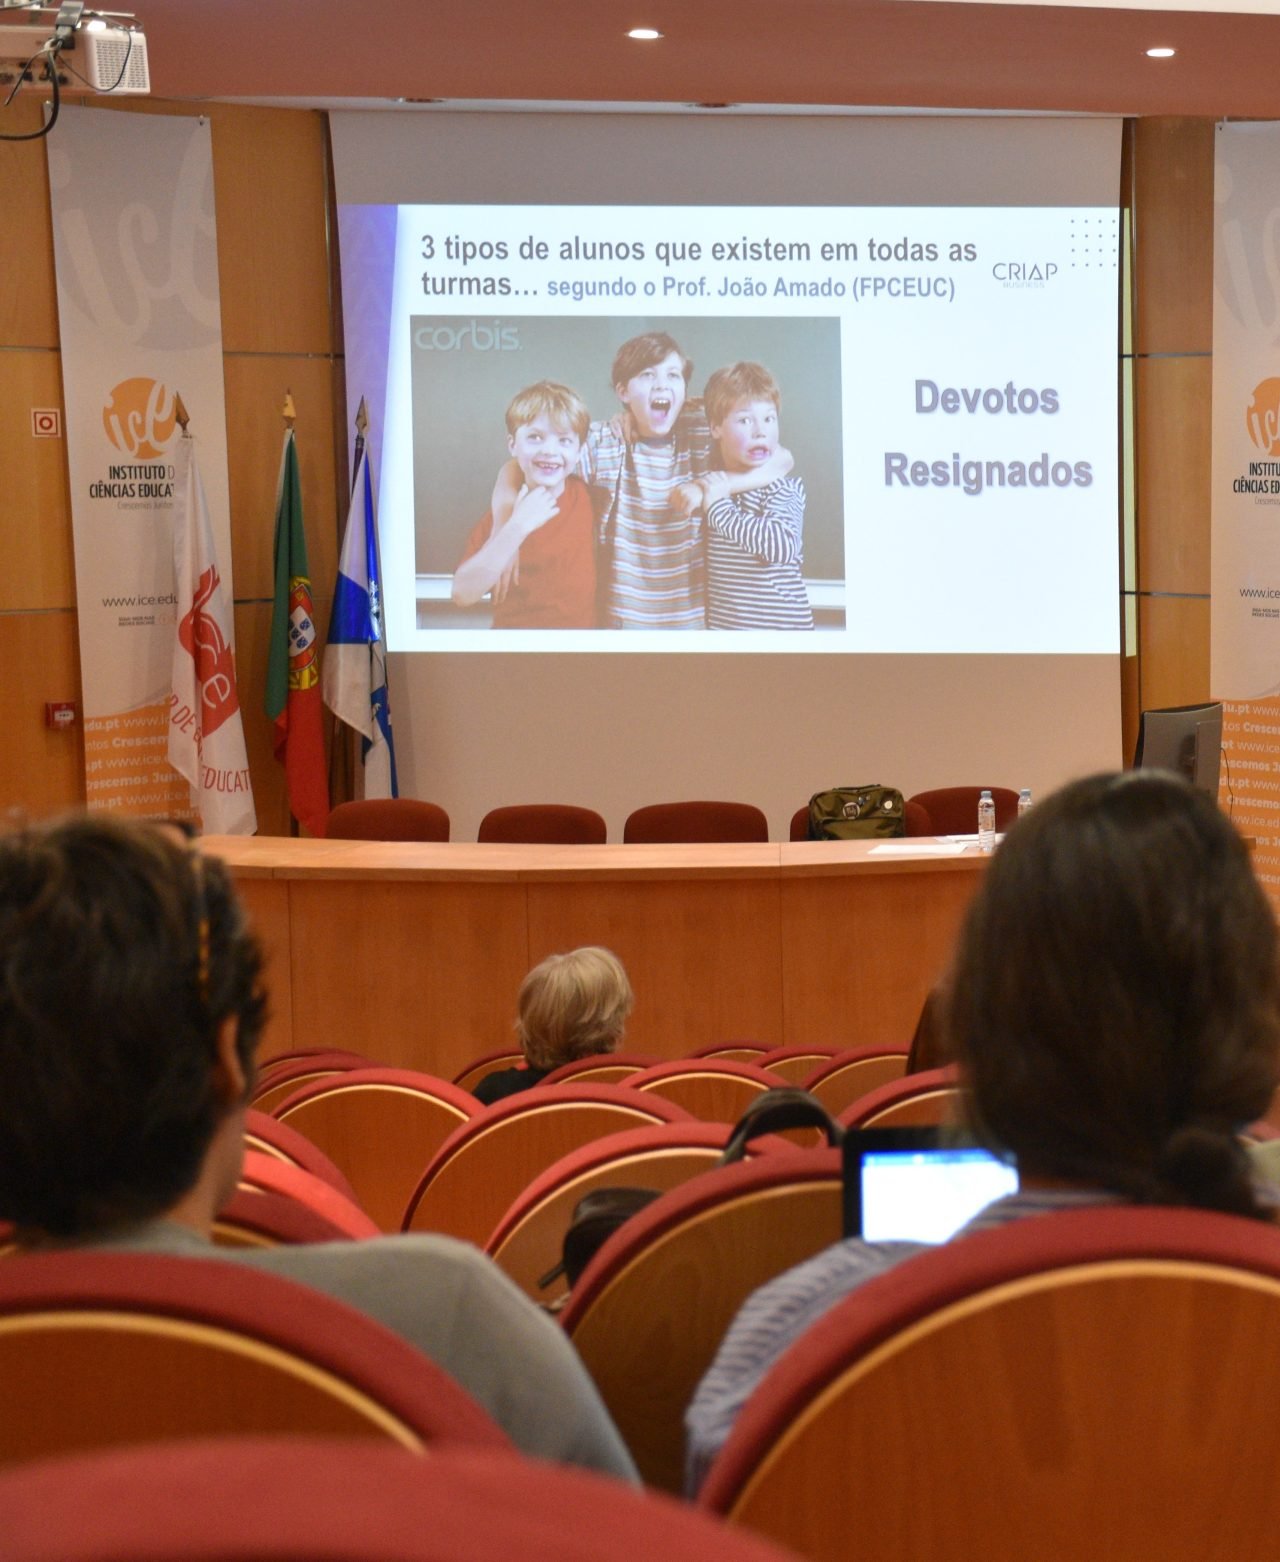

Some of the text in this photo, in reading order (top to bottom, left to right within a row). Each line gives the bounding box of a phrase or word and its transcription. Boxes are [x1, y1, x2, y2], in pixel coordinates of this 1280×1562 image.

[422, 235, 977, 266] 3 tipos de alunos que existem em todas as
[992, 262, 1058, 281] CRIAP
[547, 277, 636, 301] segundo
[644, 280, 656, 296] o
[663, 276, 711, 296] Prof.
[717, 277, 768, 297] João
[773, 277, 846, 297] Amado
[852, 277, 956, 302] (FPCEUC)
[915, 379, 1060, 414] Devotos
[108, 465, 175, 480] INSTITUTO D
[884, 452, 1093, 496] Resignados
[1233, 475, 1269, 494] CIÊNCIAS
[89, 480, 136, 499] CIÊNCIAS
[202, 765, 250, 793] DUCAT
